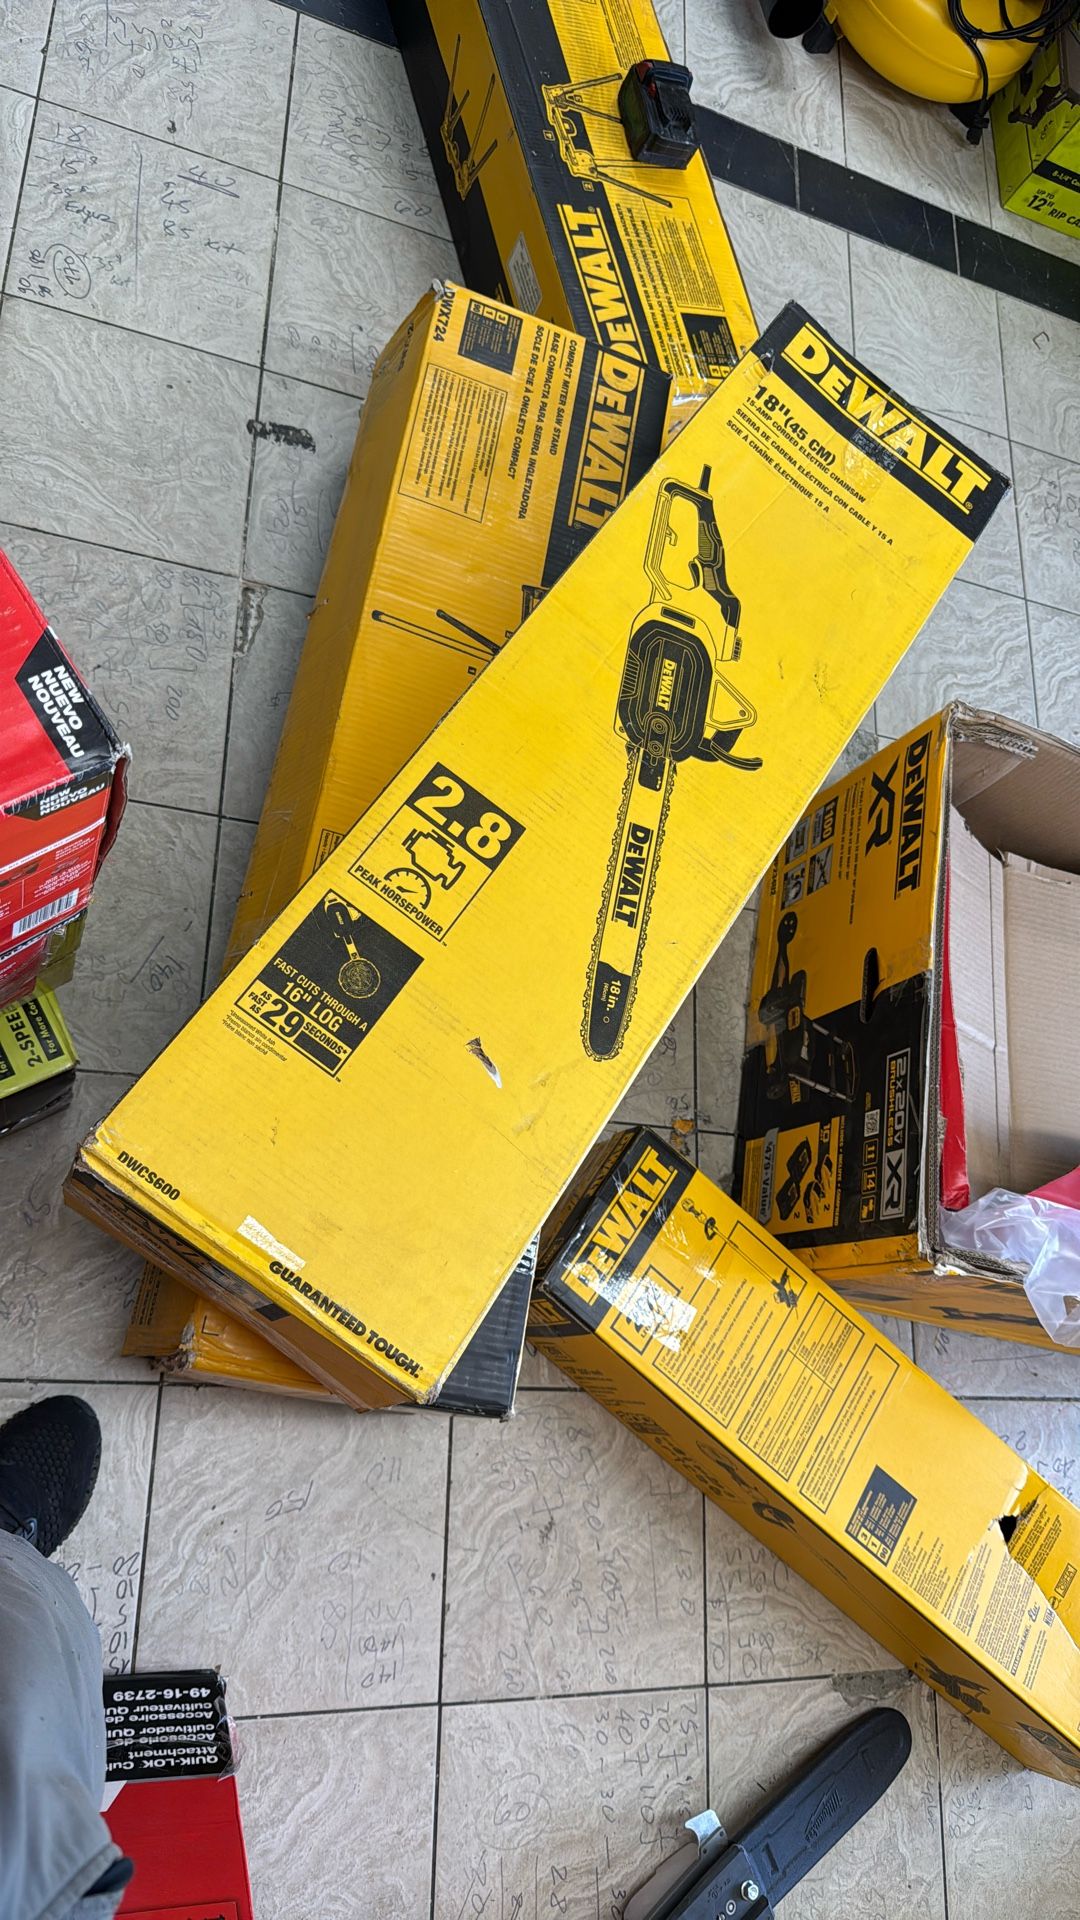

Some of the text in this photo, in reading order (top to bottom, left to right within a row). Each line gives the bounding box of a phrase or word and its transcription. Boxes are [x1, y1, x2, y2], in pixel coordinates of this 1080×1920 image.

[1044, 191, 1055, 200] TO
[1047, 207, 1067, 222] RIP
[431, 288, 456, 343] DWX724
[531, 324, 546, 353] SOCLE
[525, 365, 537, 386] SCIE
[529, 353, 540, 366] DE
[514, 394, 531, 436] ONGLETS
[547, 338, 578, 456] COMPACT MITER SAW STAND
[516, 331, 562, 520] BASE COMPACTA PARA SIERRA INGLETADORA
[505, 435, 523, 479] COMPACT
[724, 418, 743, 437] SCIE
[747, 438, 775, 465] CHAÎNE
[773, 461, 815, 499] ÉLECTRIQUE
[813, 496, 825, 508] 15
[822, 504, 831, 513] A
[744, 396, 866, 504] 15-AMP CORDED ELECTRIC CHAINSAW
[734, 407, 894, 546] SIERRA DE CADENA ELÉCTRICA CON CABLE Y 15 A
[39, 667, 84, 732] NUEVO
[52, 663, 85, 707] NEW
[26, 673, 85, 760] NOUVEAU
[38, 786, 72, 806] NEW
[38, 786, 88, 811] NUEVO
[38, 782, 106, 816] NOUVEAU
[411, 769, 518, 864] 2.8
[865, 754, 900, 857] XR
[353, 863, 444, 936] PEAK HORSEPOWER
[247, 991, 267, 1008] FAST
[260, 989, 272, 1001] AS
[272, 956, 369, 1032] FAST CUTS THROUGH A
[279, 979, 344, 1033] 16" LOG
[608, 978, 623, 995] 18
[248, 1002, 261, 1014] AS
[258, 994, 308, 1041] 29
[32, 1014, 56, 1055] For More
[266, 1036, 276, 1046] Ash
[888, 1060, 898, 1148] BRUSHLESS
[115, 1149, 182, 1202] DWCS600
[266, 1258, 369, 1338] GUARANTEED
[112, 1685, 211, 1702] 49-16-2739
[132, 1701, 212, 1714] cultivateur
[104, 1709, 213, 1724] Accessoire de
[138, 1722, 215, 1736] cultivador
[127, 1745, 217, 1759] Attachment
[142, 1754, 218, 1768] QUIK-LOK
